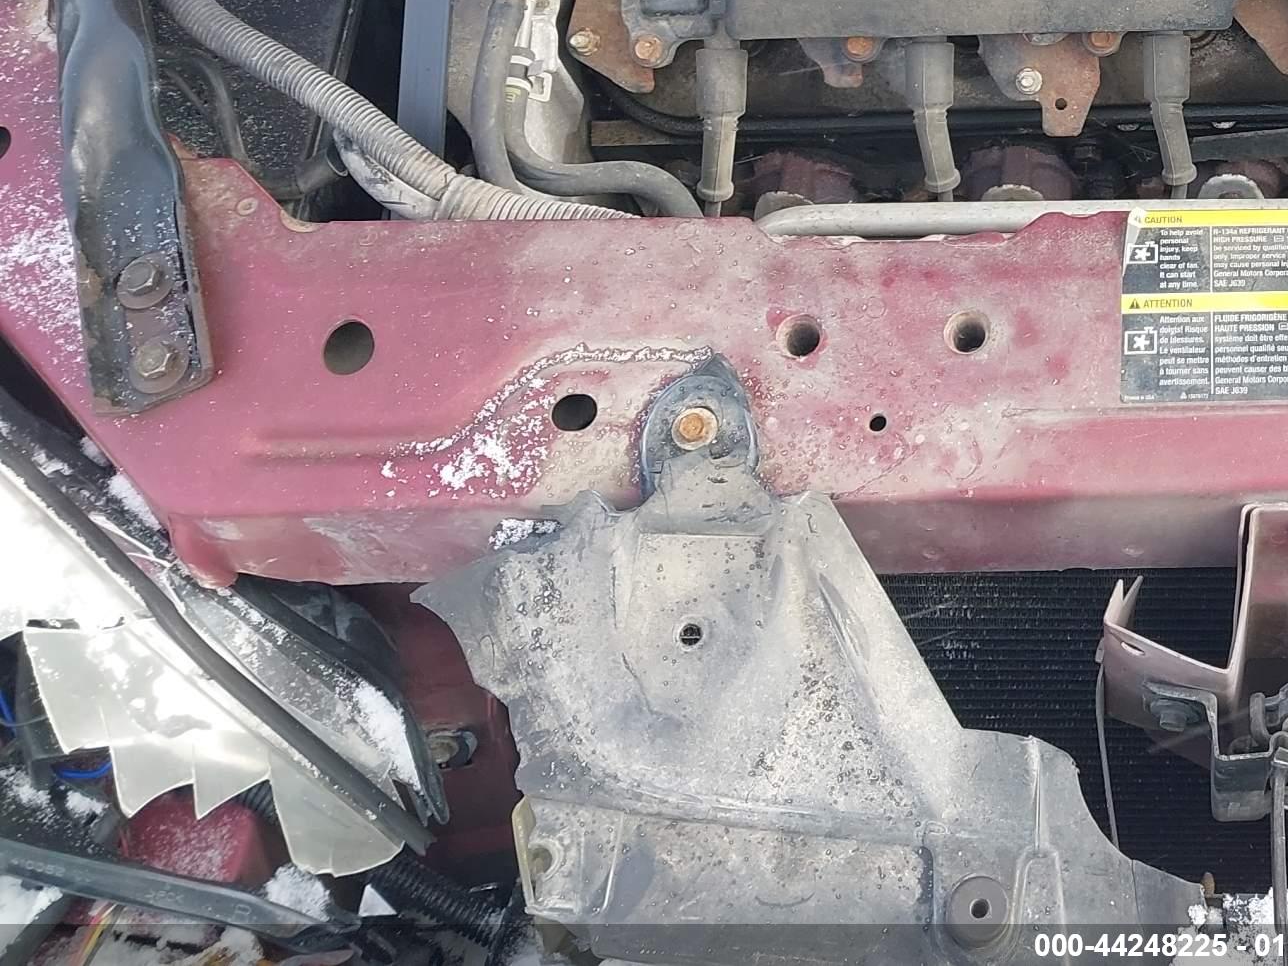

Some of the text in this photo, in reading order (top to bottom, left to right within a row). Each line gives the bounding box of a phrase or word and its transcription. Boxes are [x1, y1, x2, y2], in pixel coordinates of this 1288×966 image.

[1144, 216, 1183, 224] CAUTION
[1160, 238, 1189, 246] personal
[1231, 235, 1267, 243] PRESSURE
[1240, 269, 1264, 277] Motors
[1213, 279, 1228, 287] SAE
[1143, 298, 1193, 308] ATTENTION
[1159, 315, 1191, 324] Attention
[1214, 314, 1240, 322] FLUIDE
[1184, 325, 1208, 334] Risque
[1214, 324, 1238, 332] HAUTE
[1239, 323, 1275, 332] PRESSION
[1214, 344, 1249, 353] personnel
[1159, 357, 1175, 366] peut
[1214, 365, 1243, 374] peuvent
[1243, 365, 1267, 373] causer
[1268, 364, 1282, 373] des
[1214, 375, 1241, 384] General
[1242, 375, 1266, 384] Motors
[1214, 386, 1248, 395] SAE J639
